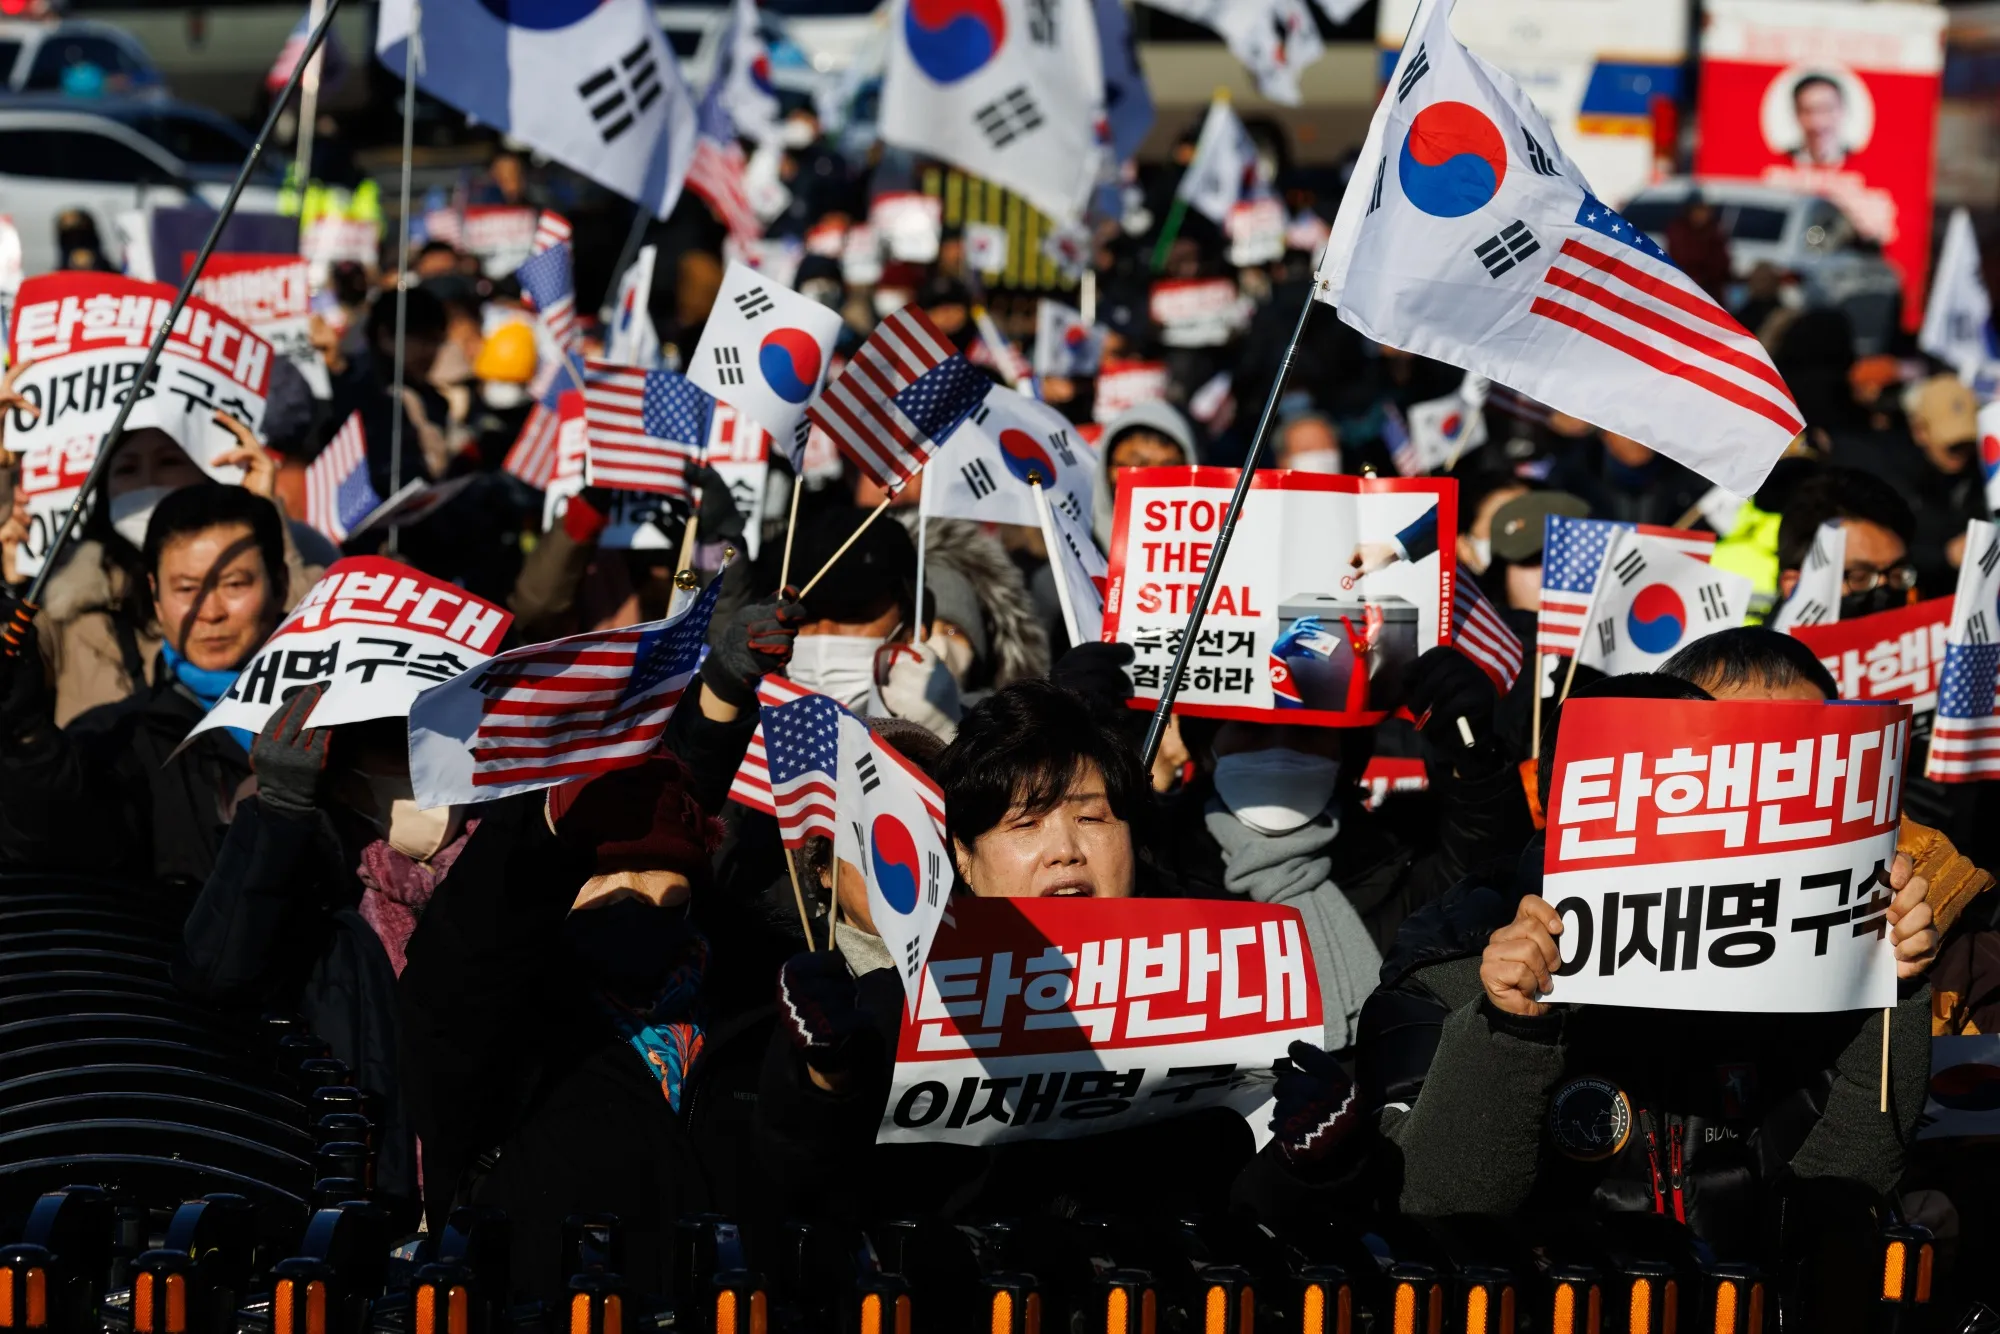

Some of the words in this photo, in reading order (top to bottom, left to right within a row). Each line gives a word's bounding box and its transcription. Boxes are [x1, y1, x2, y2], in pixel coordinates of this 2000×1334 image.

[15, 294, 270, 394] 탄핵반대
[1142, 542, 1214, 573] THE
[1441, 571, 1450, 598] SAVE
[1440, 601, 1449, 637] KOREA
[1559, 718, 1907, 861] 탄핵반대
[1553, 878, 1781, 977] 이재명
[917, 920, 1307, 1052] 탄핵반대
[892, 1068, 1145, 1130] 이재명
